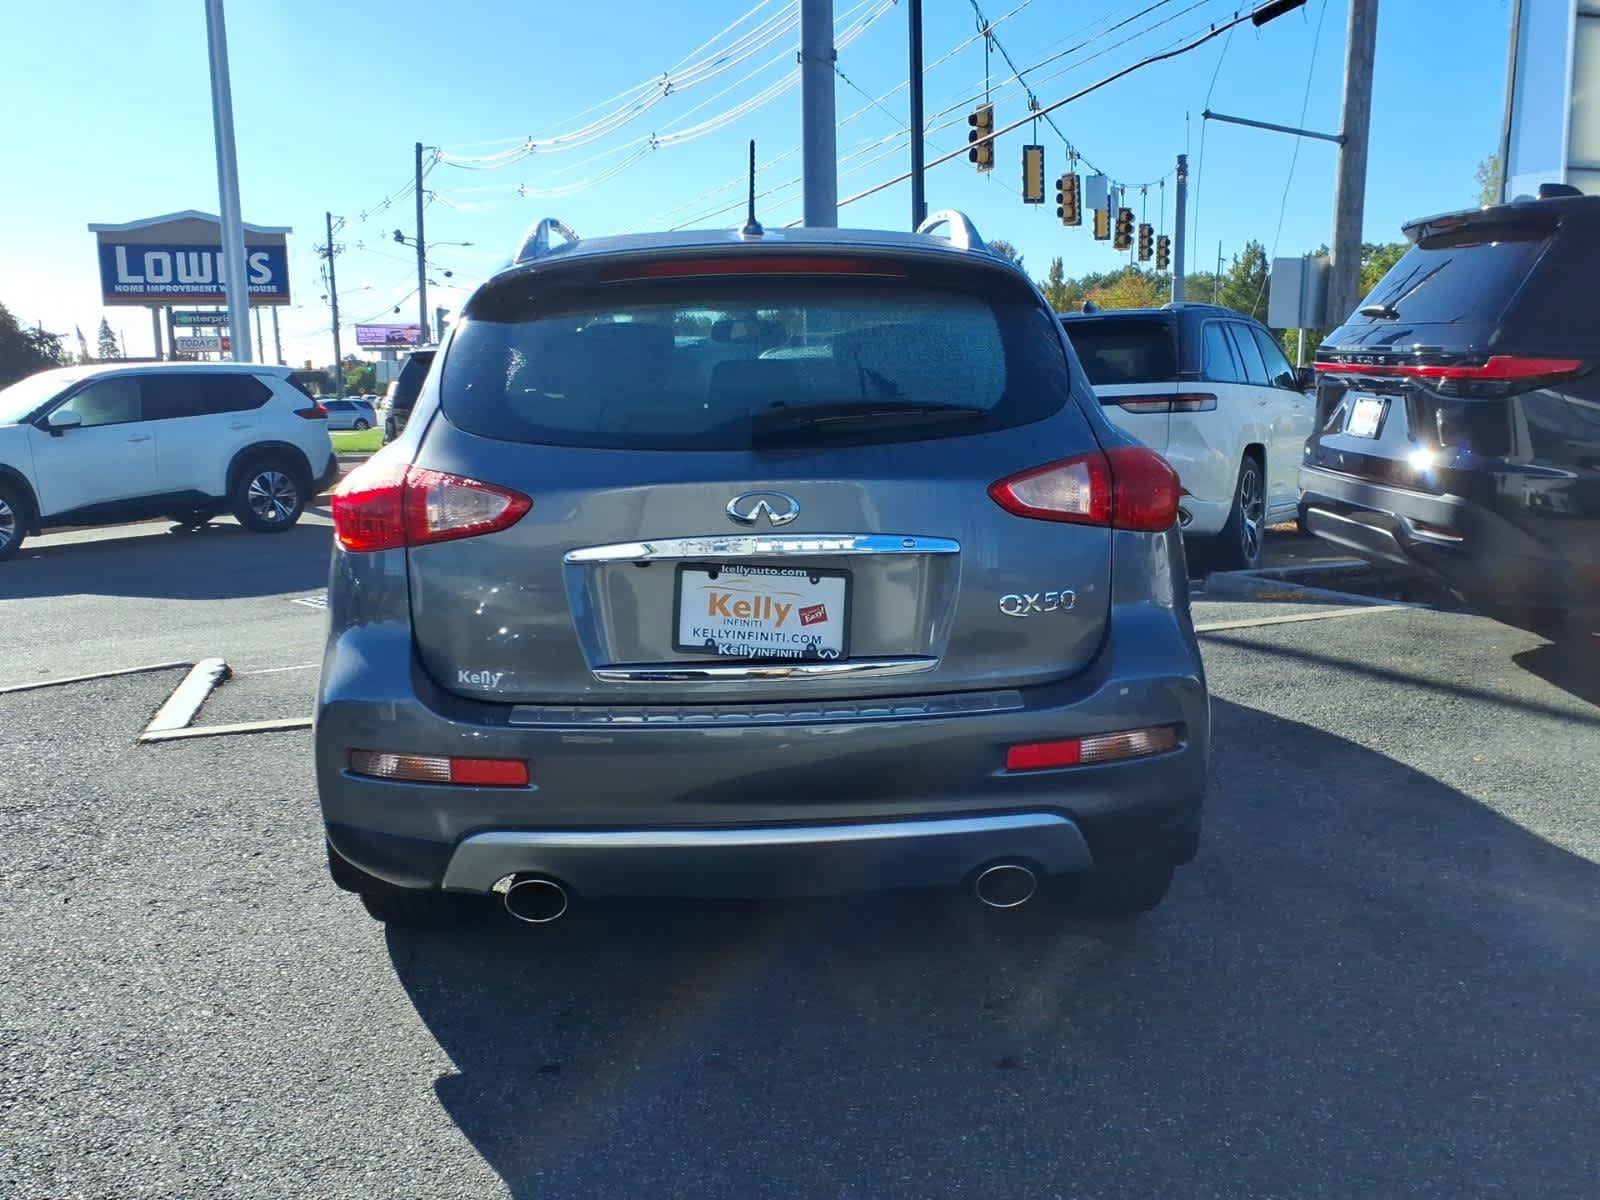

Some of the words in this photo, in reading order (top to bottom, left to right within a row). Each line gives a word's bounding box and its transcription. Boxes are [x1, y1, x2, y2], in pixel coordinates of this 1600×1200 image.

[115, 285, 144, 293] HOME
[147, 285, 217, 293] IMPROVEMENT
[721, 564, 807, 578] kellyauto.com
[708, 592, 792, 628] Kelly
[999, 590, 1076, 617] QX50
[723, 618, 763, 628] INFINITI
[692, 627, 822, 645] KELLYINFINITI.COM
[458, 670, 502, 688] Kelly
